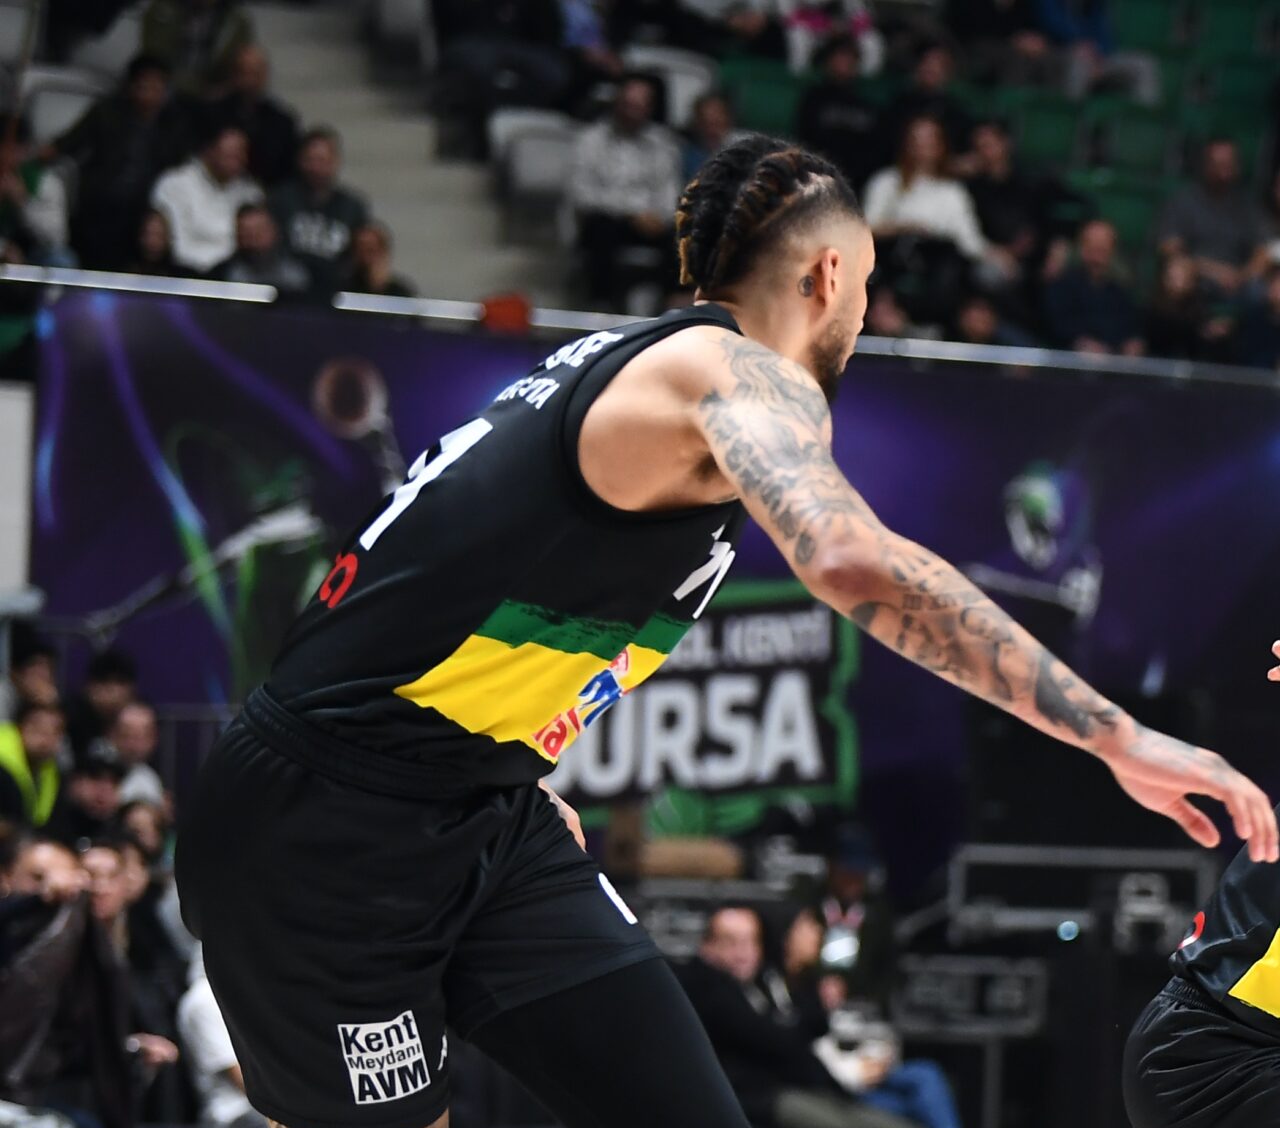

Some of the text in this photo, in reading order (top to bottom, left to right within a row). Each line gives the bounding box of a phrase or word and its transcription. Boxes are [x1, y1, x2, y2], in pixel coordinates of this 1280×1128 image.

[549, 670, 825, 798] URSA
[340, 1014, 417, 1056] Kent
[358, 1058, 428, 1102] AVM
